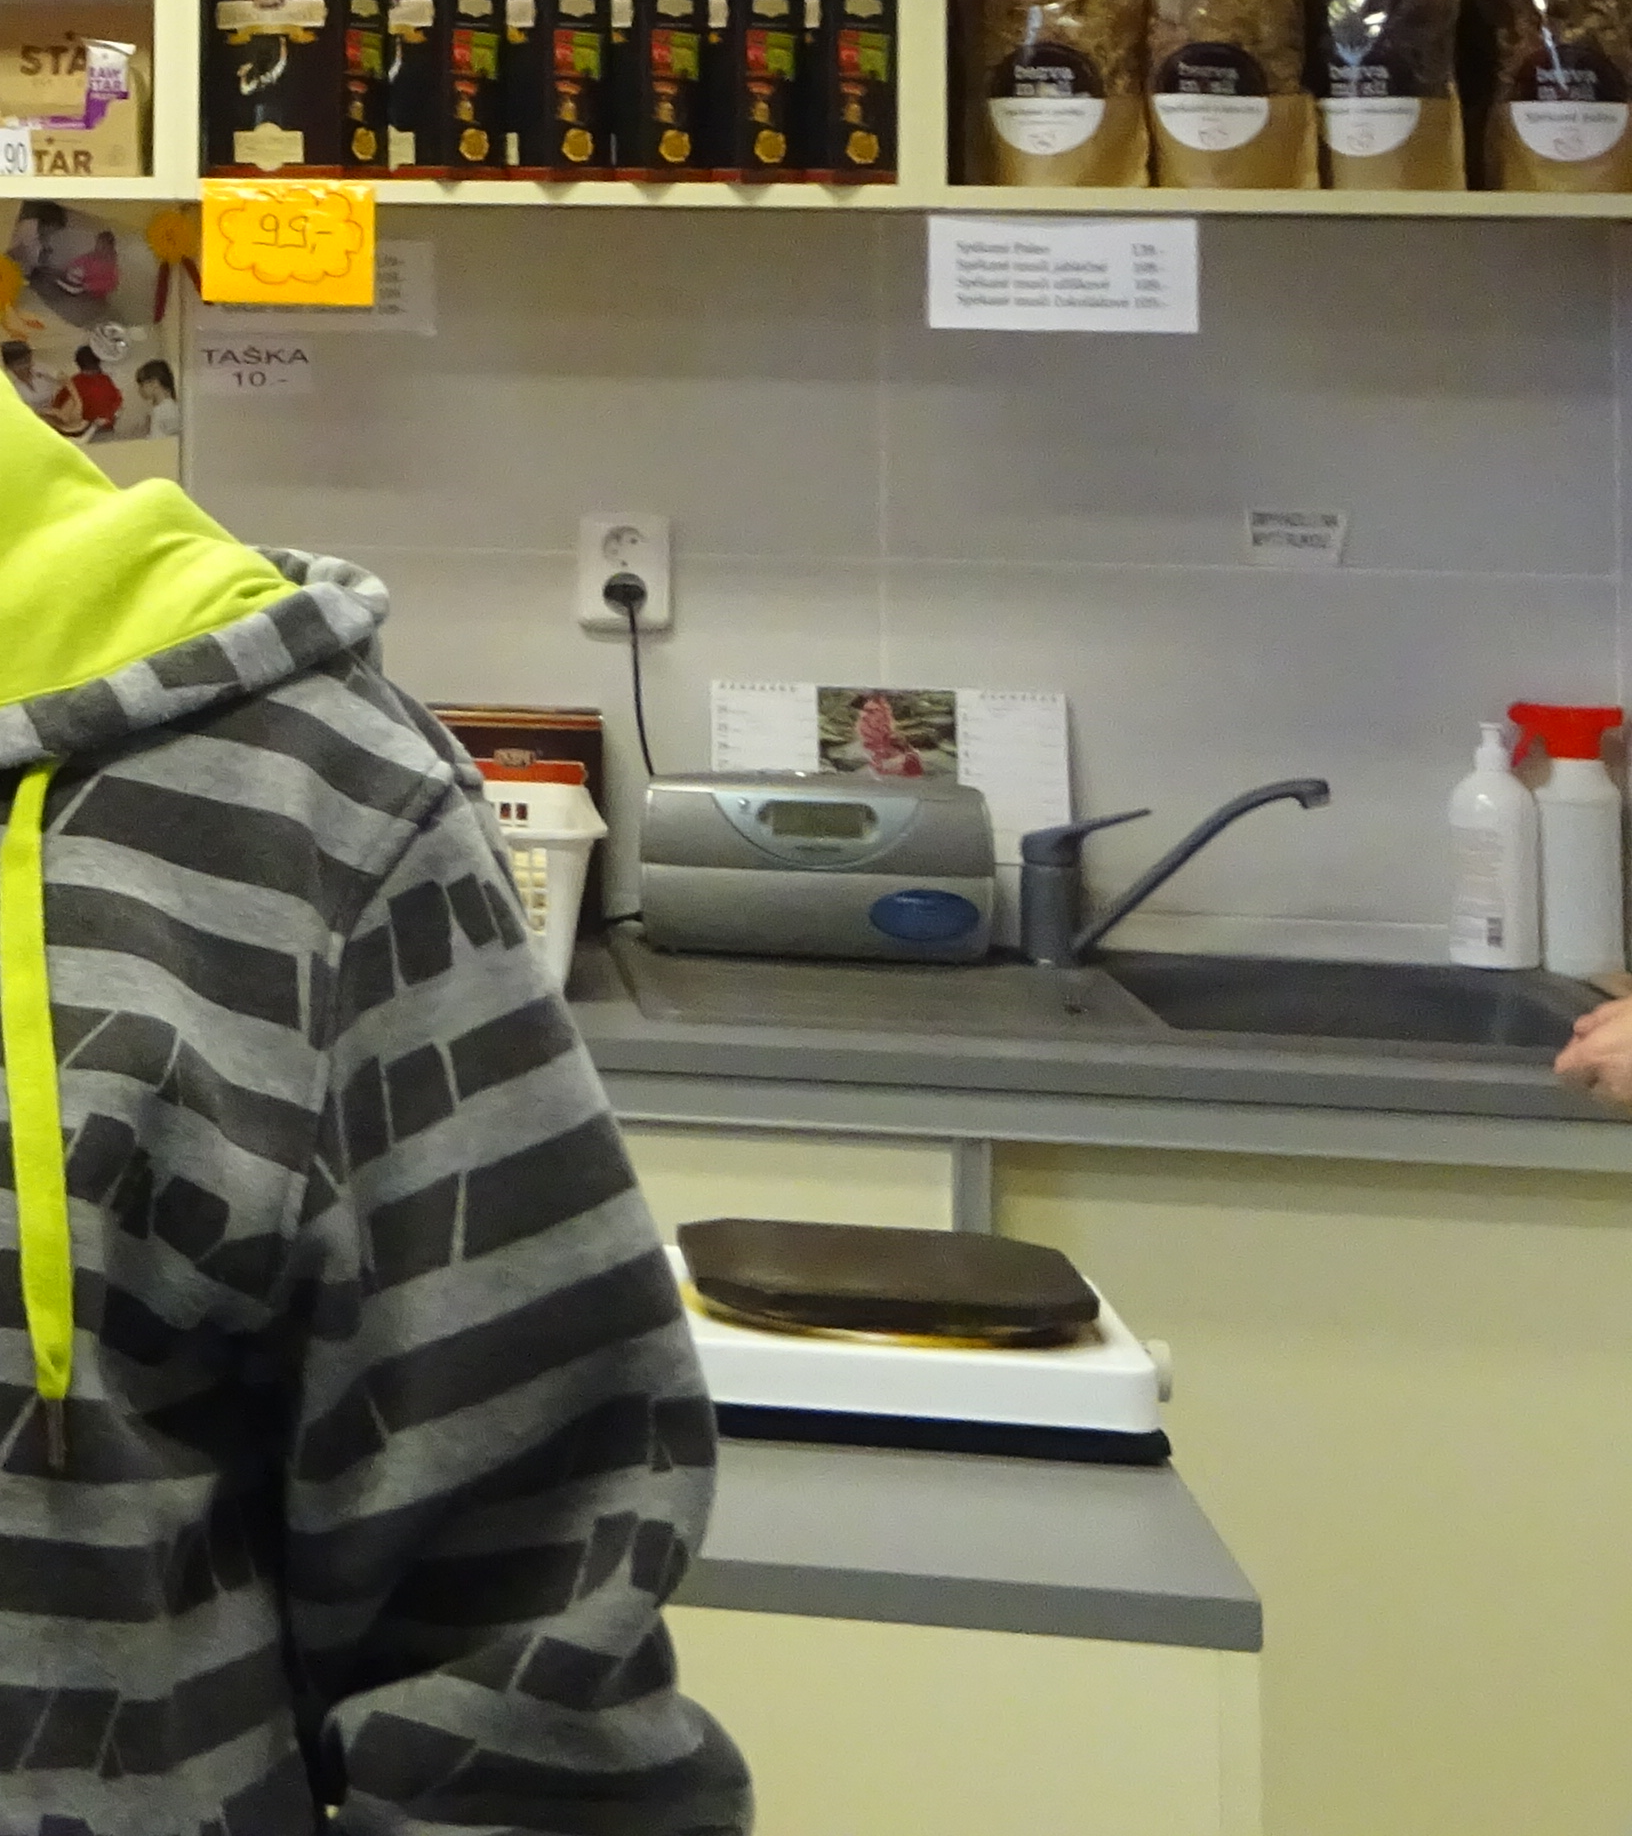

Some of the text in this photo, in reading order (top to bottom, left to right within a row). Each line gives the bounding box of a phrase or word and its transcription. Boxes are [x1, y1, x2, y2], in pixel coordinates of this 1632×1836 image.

[19, 44, 87, 77] STA
[32, 148, 93, 175] TAR
[251, 212, 334, 255] 99,-
[202, 346, 310, 365] TAŠKA
